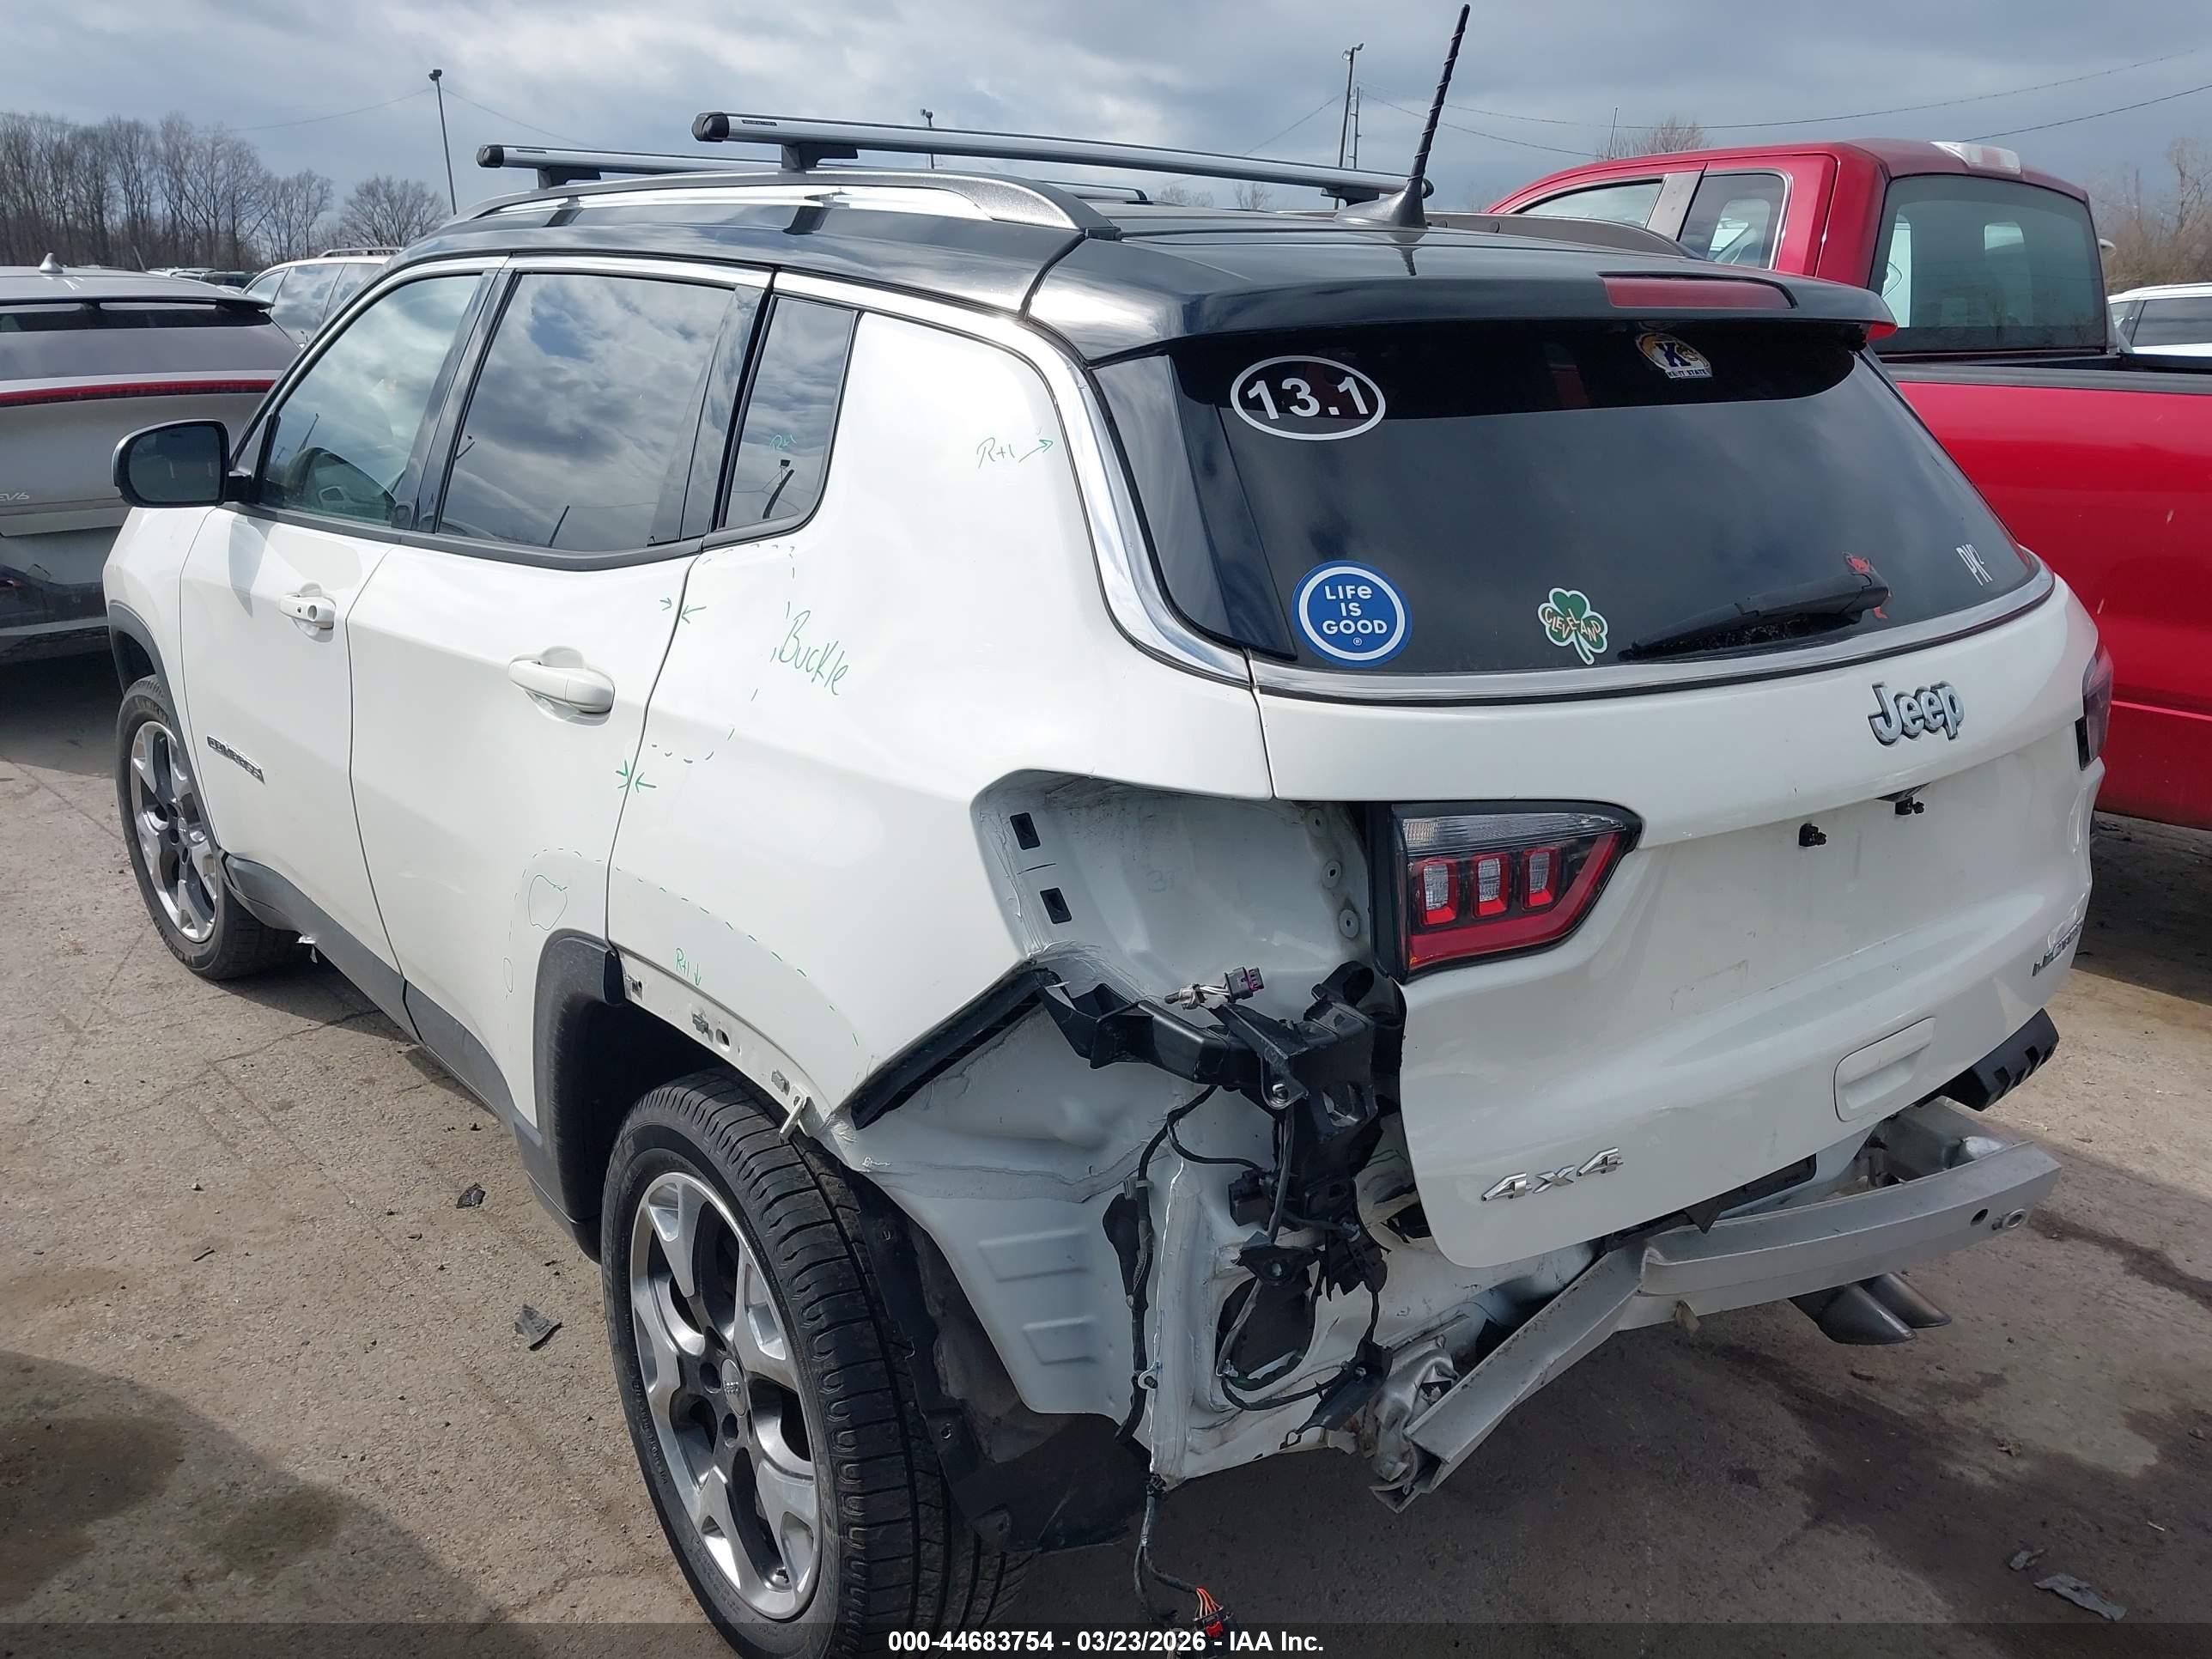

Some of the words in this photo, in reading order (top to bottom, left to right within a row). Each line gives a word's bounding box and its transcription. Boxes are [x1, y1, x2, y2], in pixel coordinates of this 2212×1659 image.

[1247, 377, 1370, 420] 13.1
[1322, 619, 1388, 635] GOOD
[1340, 602, 1362, 617] IS
[1545, 607, 1601, 642] CLEVELAND
[1867, 683, 1965, 746] Jeep
